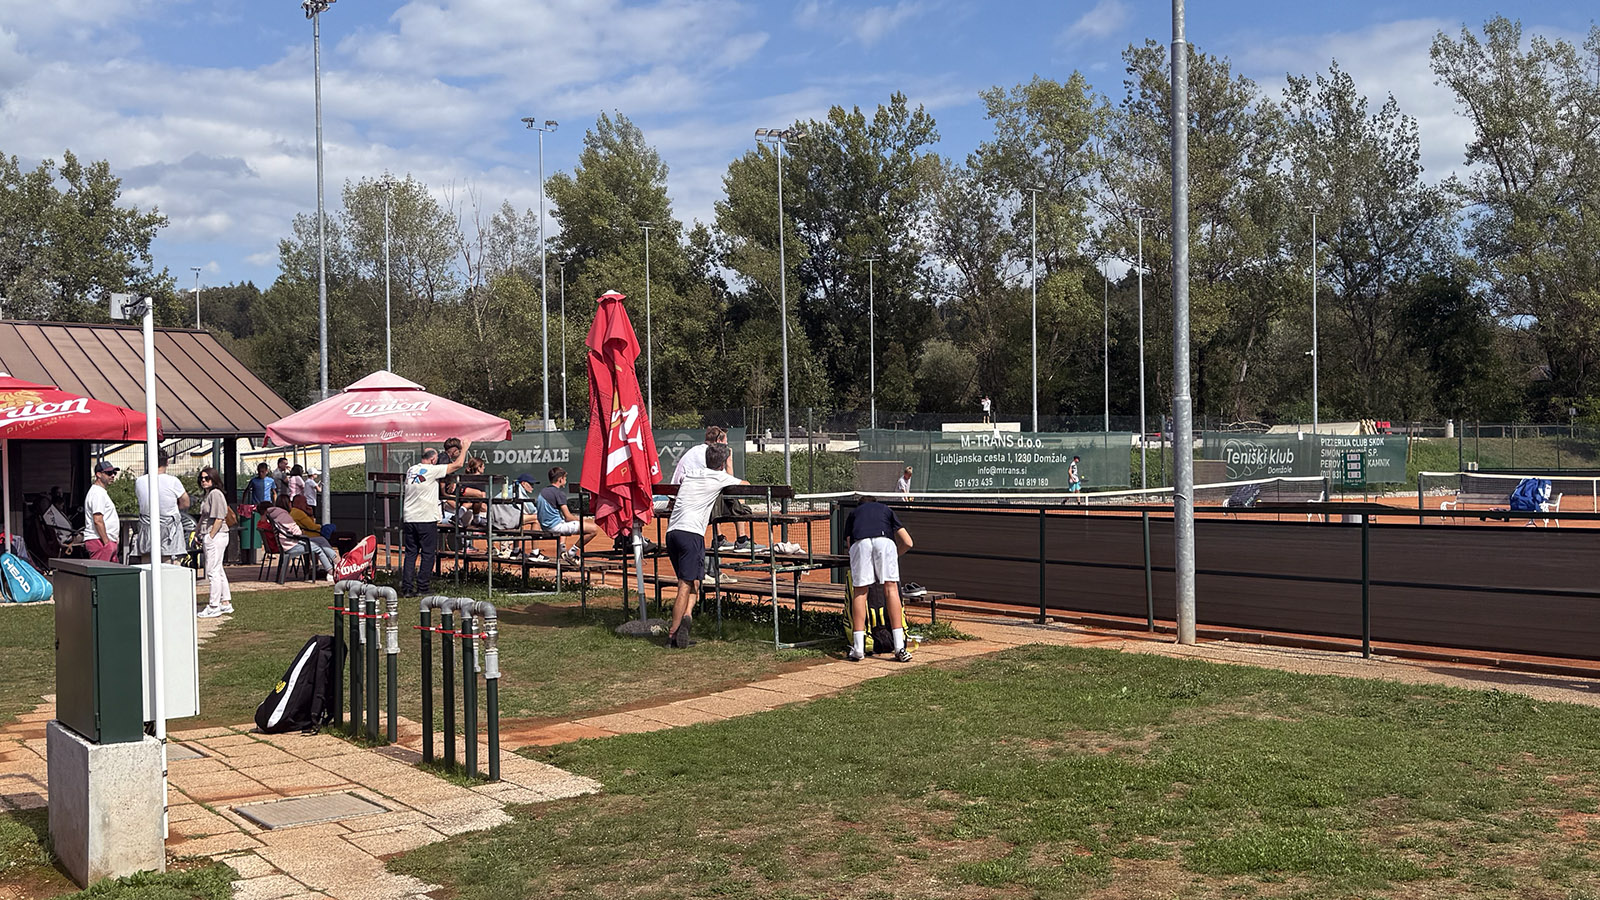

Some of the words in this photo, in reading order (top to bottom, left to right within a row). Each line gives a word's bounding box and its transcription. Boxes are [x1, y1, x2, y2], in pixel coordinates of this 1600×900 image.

[0, 398, 91, 427] nion
[343, 401, 431, 417] Union
[380, 429, 404, 441] Union
[960, 434, 1014, 448] M-TRANS
[1017, 435, 1045, 448] d.o.o.
[1320, 438, 1352, 447] PIZZERIJA
[1352, 438, 1368, 447] CLUB
[493, 445, 570, 464] DOMŽALE
[935, 453, 982, 465] Ljubljanska
[984, 453, 1006, 463] cesta
[1015, 453, 1032, 463] 1230
[1033, 453, 1067, 463] Domžale
[1226, 448, 1268, 465] Teniški
[1269, 448, 1295, 464] klub
[1320, 459, 1344, 468] PEROV
[977, 466, 1028, 476] info@mtrans.si
[954, 479, 966, 488] 051
[967, 478, 979, 487] 673
[981, 477, 994, 486] 435
[1014, 478, 1025, 487] 041
[1026, 478, 1037, 487] 819
[1038, 478, 1049, 487] 180
[340, 561, 369, 575] Wilson
[3, 558, 31, 593] HEAD
